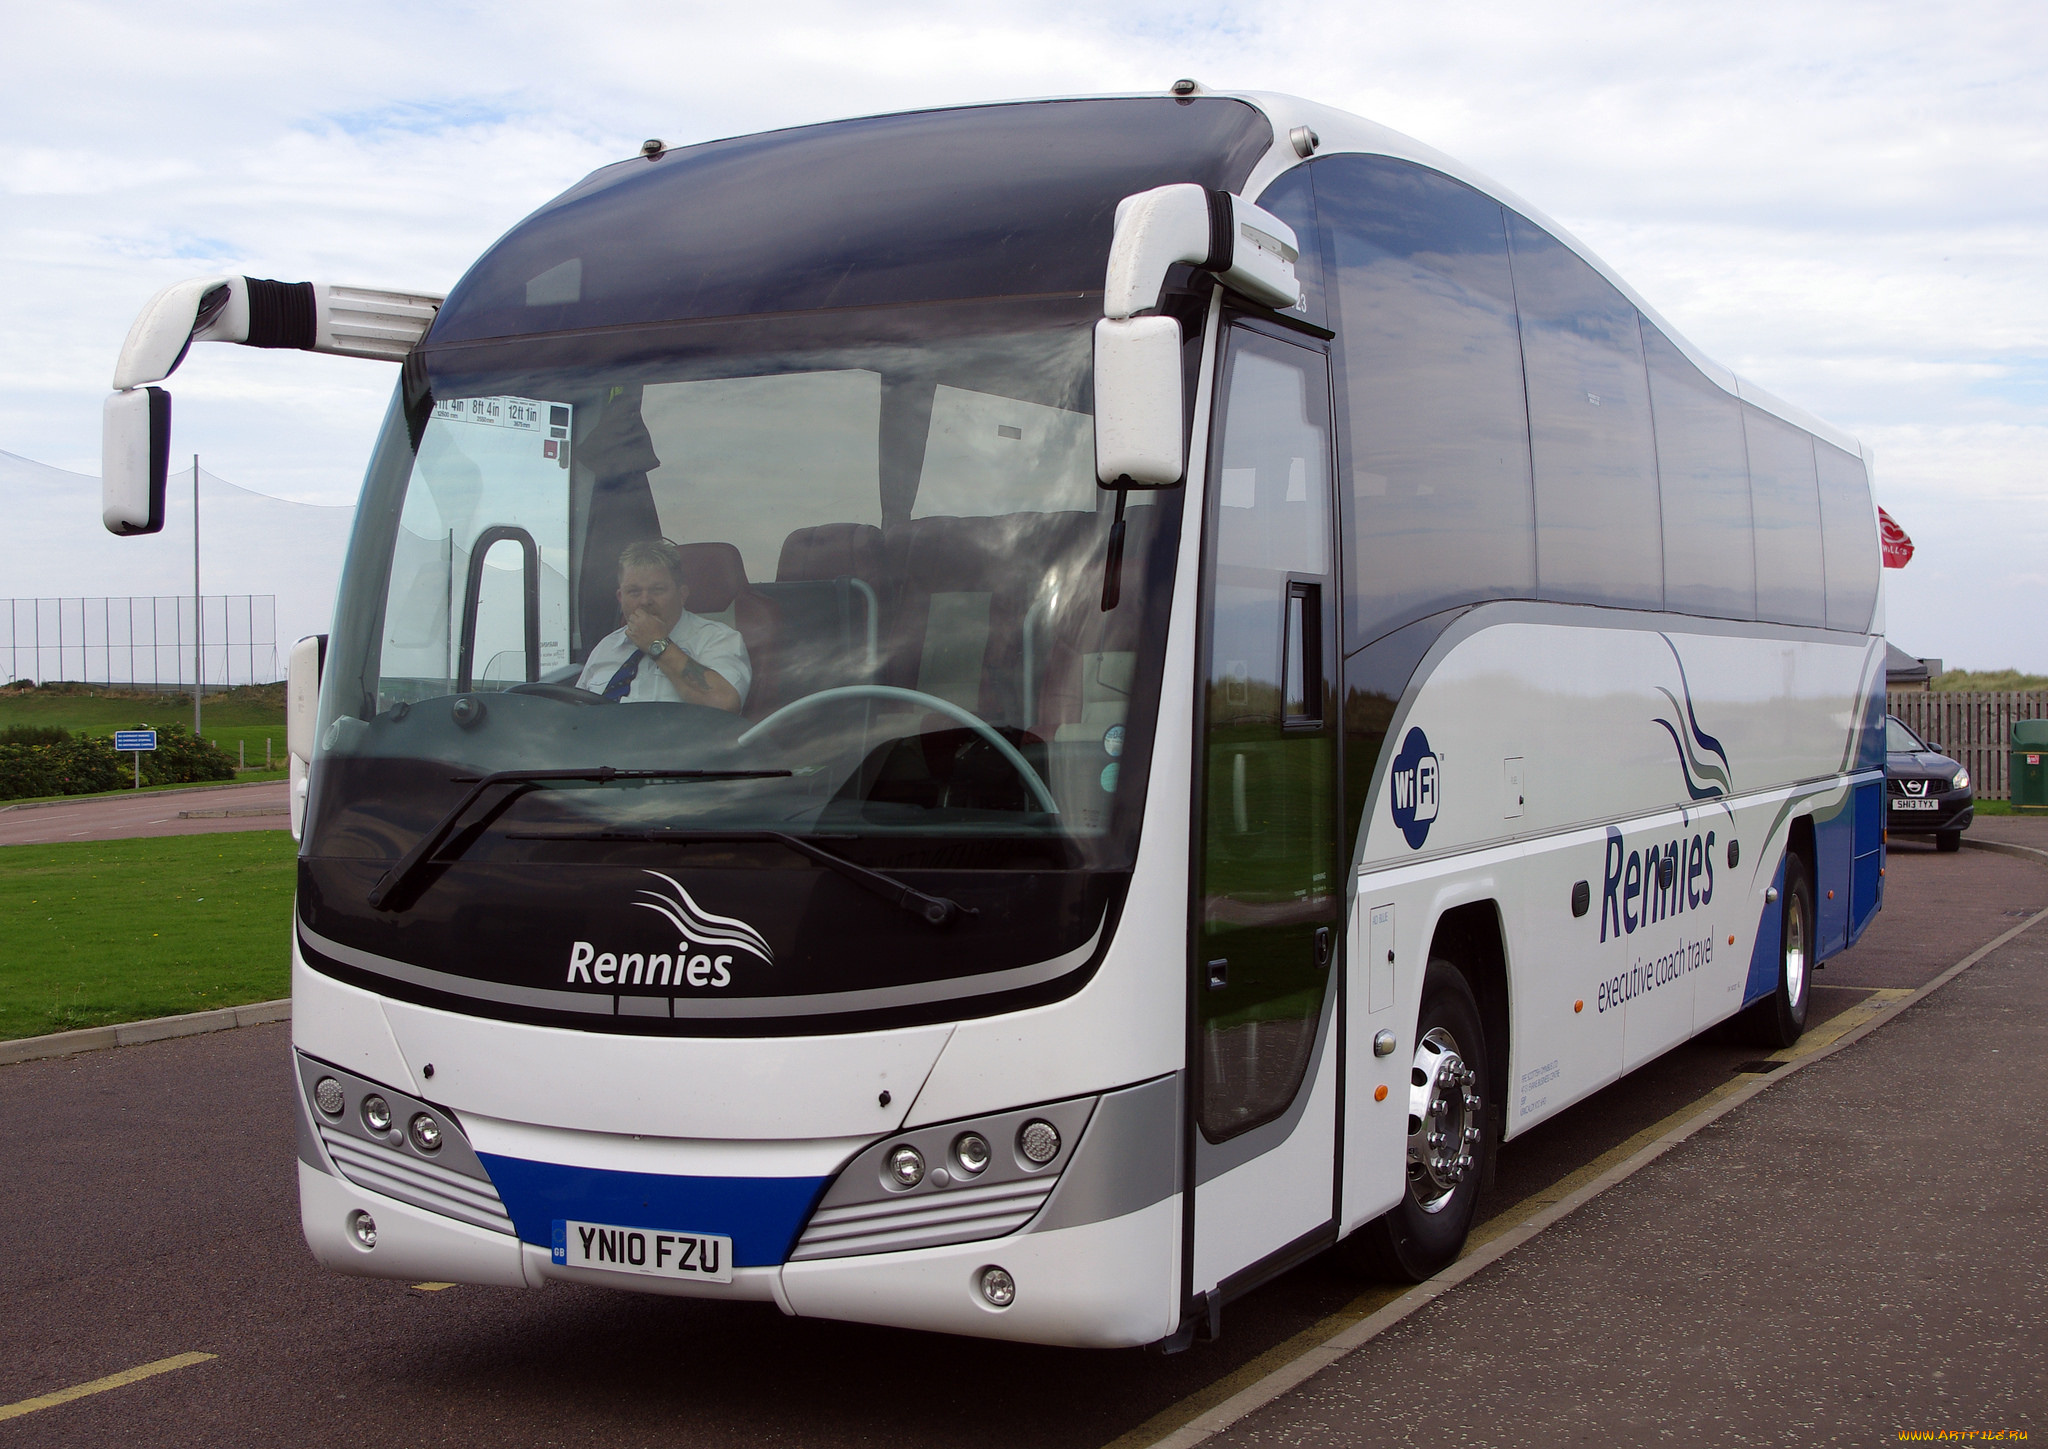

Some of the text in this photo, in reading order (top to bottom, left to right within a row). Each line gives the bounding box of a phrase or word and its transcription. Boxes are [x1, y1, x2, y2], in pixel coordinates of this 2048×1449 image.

[472, 400, 484, 415] 8ft
[486, 401, 500, 417] 4in
[508, 405, 524, 421] 12ft
[1897, 800, 1934, 808] SH13 TYX
[1600, 808, 1715, 944] Rennies
[566, 941, 733, 987] Rennies
[1598, 924, 1714, 1013] executive coach travel
[553, 1247, 565, 1257] GB
[578, 1226, 719, 1274] YN10 FZU
